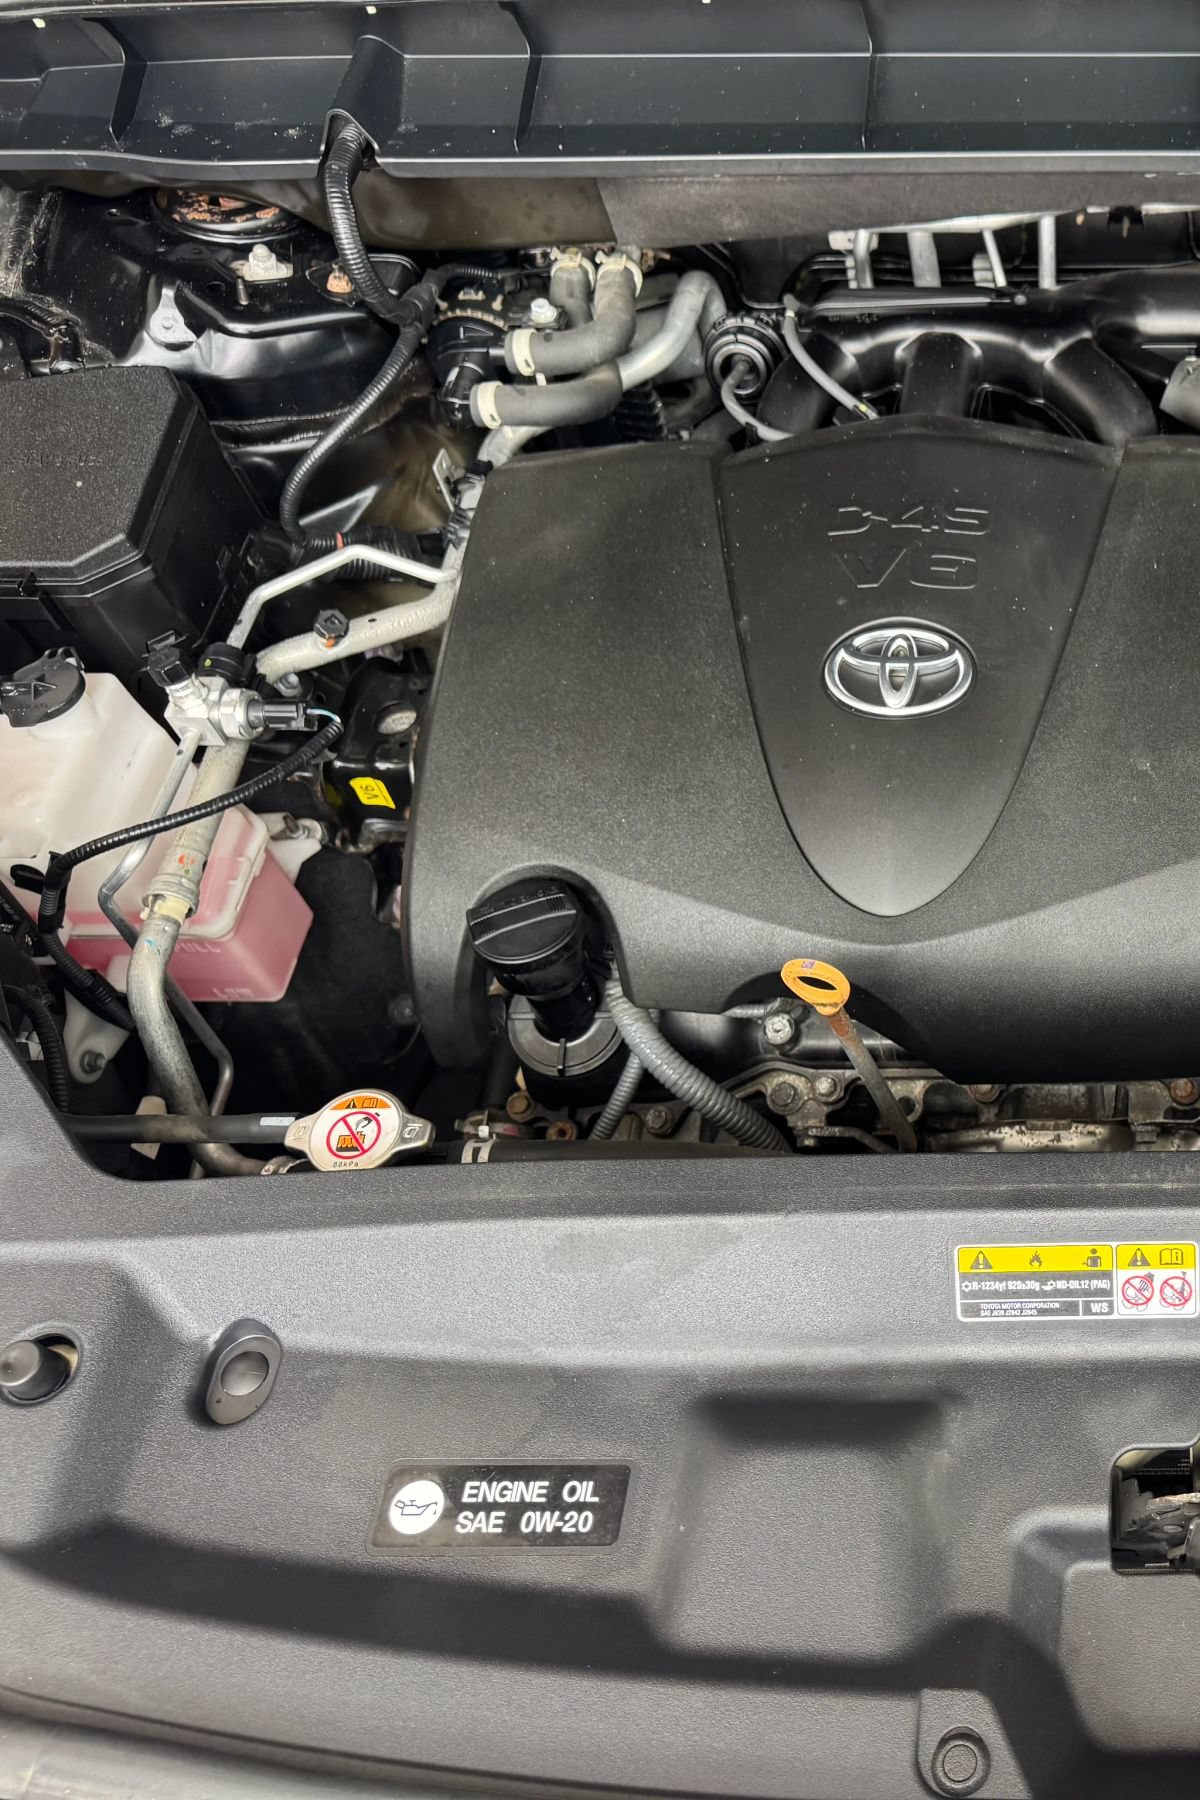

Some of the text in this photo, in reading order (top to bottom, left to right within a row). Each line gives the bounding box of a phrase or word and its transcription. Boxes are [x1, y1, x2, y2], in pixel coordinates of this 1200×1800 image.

[833, 548, 977, 590] V6
[1090, 1279, 1110, 1290] (PAG)
[1021, 1301, 1060, 1309] CORPORATION
[1090, 1302, 1110, 1313] WS
[461, 1480, 600, 1503] ENGINE OIL
[455, 1510, 593, 1533] SAE 0W-20
